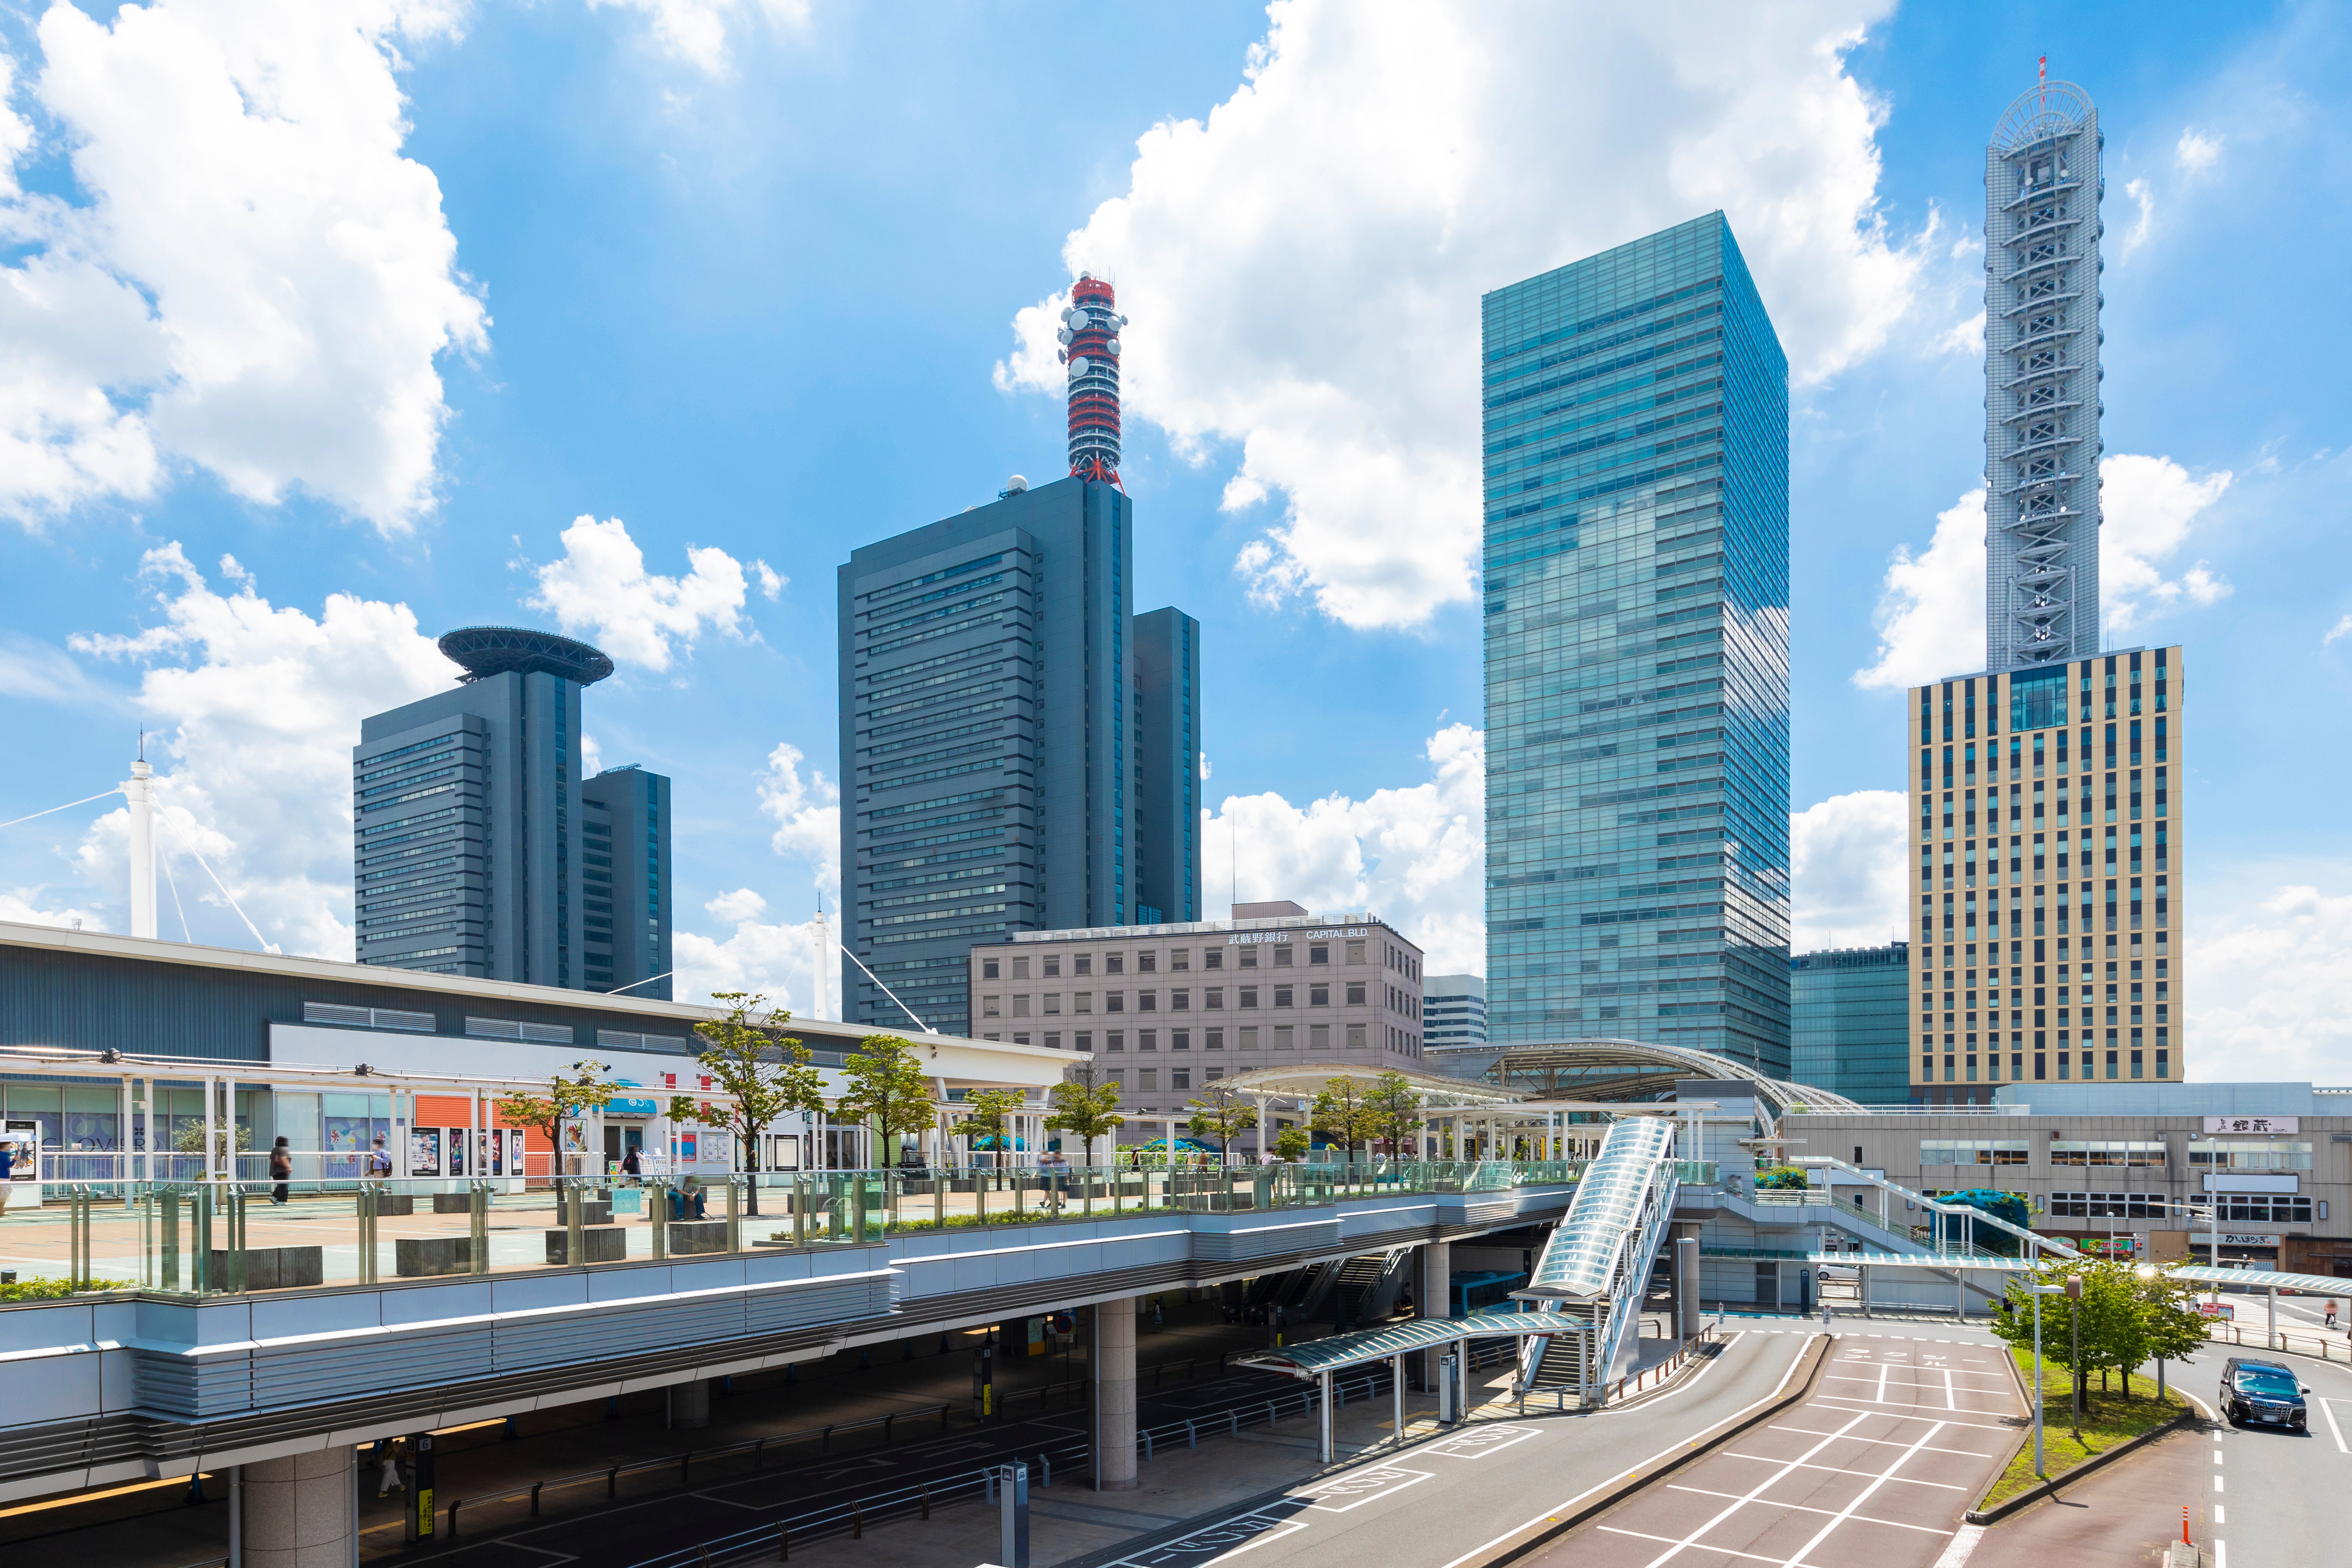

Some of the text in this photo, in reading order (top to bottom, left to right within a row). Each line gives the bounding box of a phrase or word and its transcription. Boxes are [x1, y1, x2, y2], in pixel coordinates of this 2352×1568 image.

[1228, 931, 1289, 945] 武蔵野銀行
[2232, 1119, 2271, 1132] 銀蔵
[2225, 1235, 2268, 1244] かっぽうぎ
[422, 1440, 429, 1449] 6
[1446, 1428, 1519, 1451] タクシー
[1311, 1471, 1406, 1502] タクシー
[1150, 1520, 1275, 1564] タクシー
